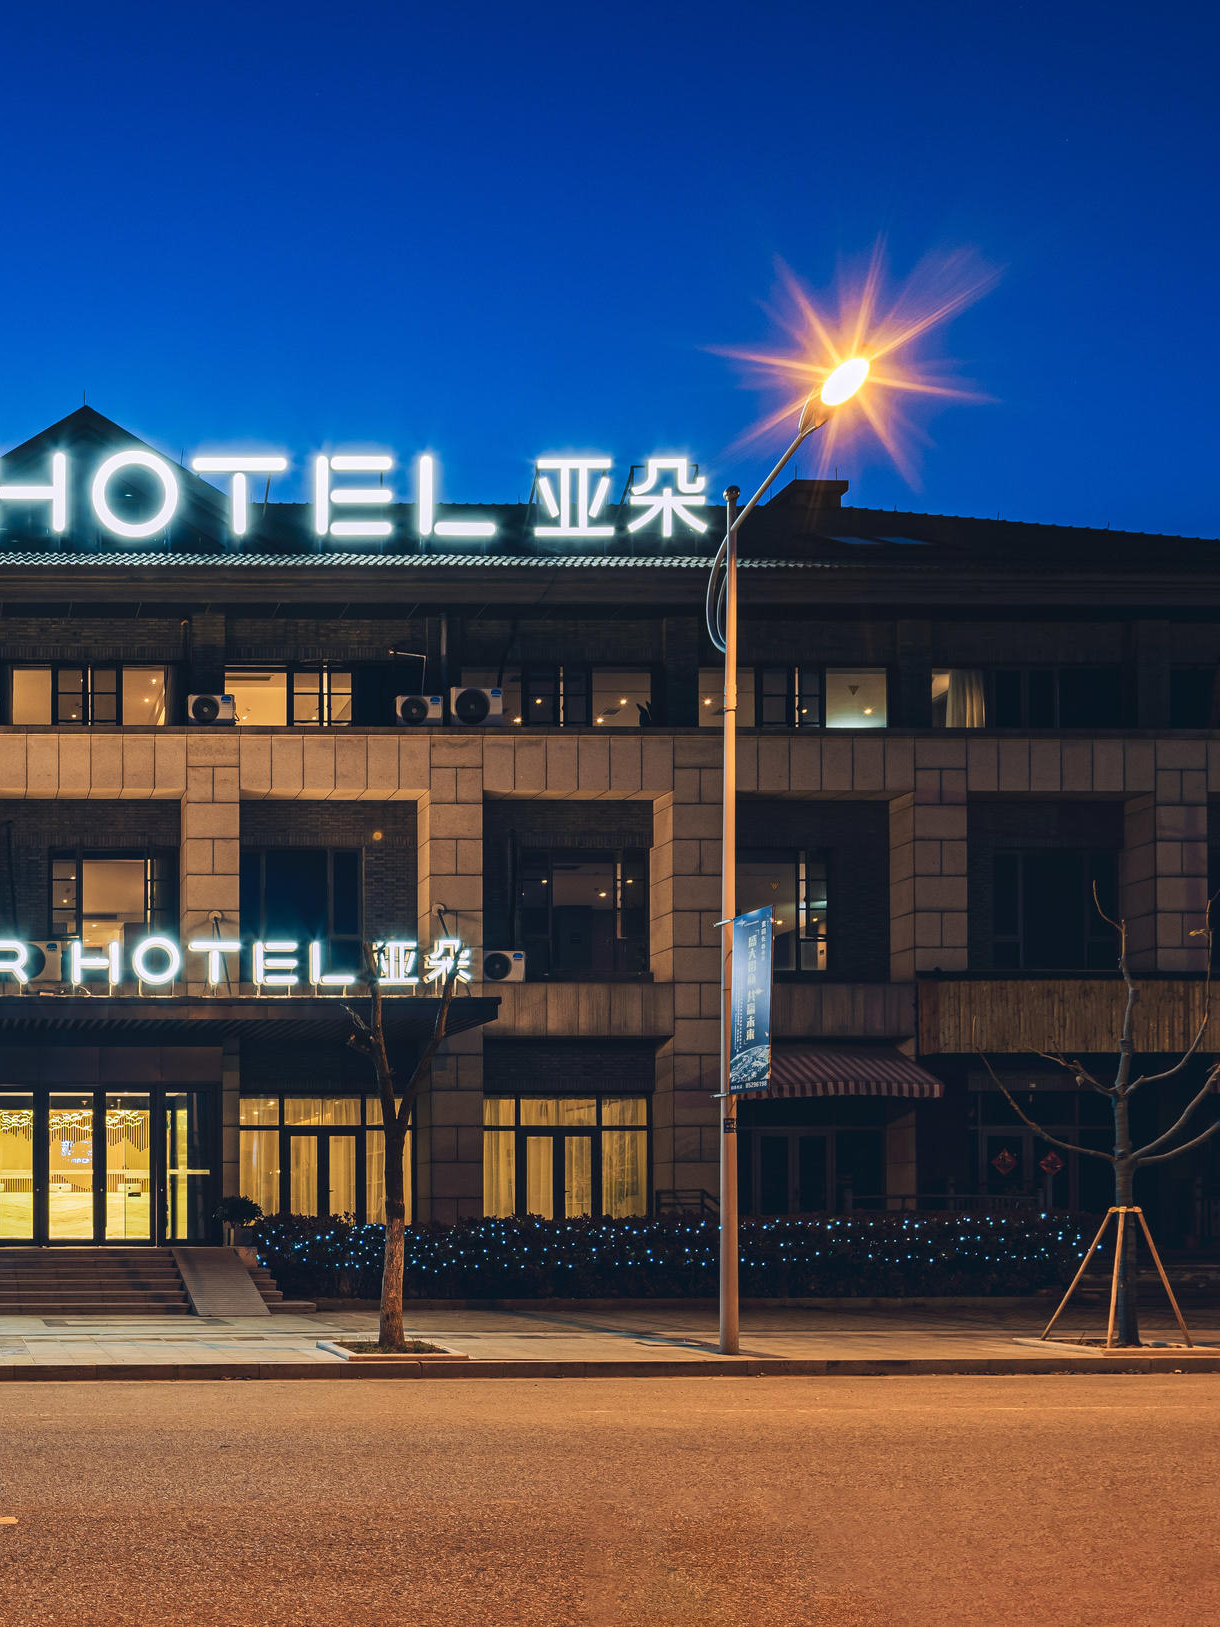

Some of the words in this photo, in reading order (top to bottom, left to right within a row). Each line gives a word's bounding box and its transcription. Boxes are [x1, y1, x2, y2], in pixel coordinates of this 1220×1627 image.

[534, 457, 708, 538] 亚朵
[70, 936, 355, 986] HOTEL
[373, 939, 472, 984] 亚朵
